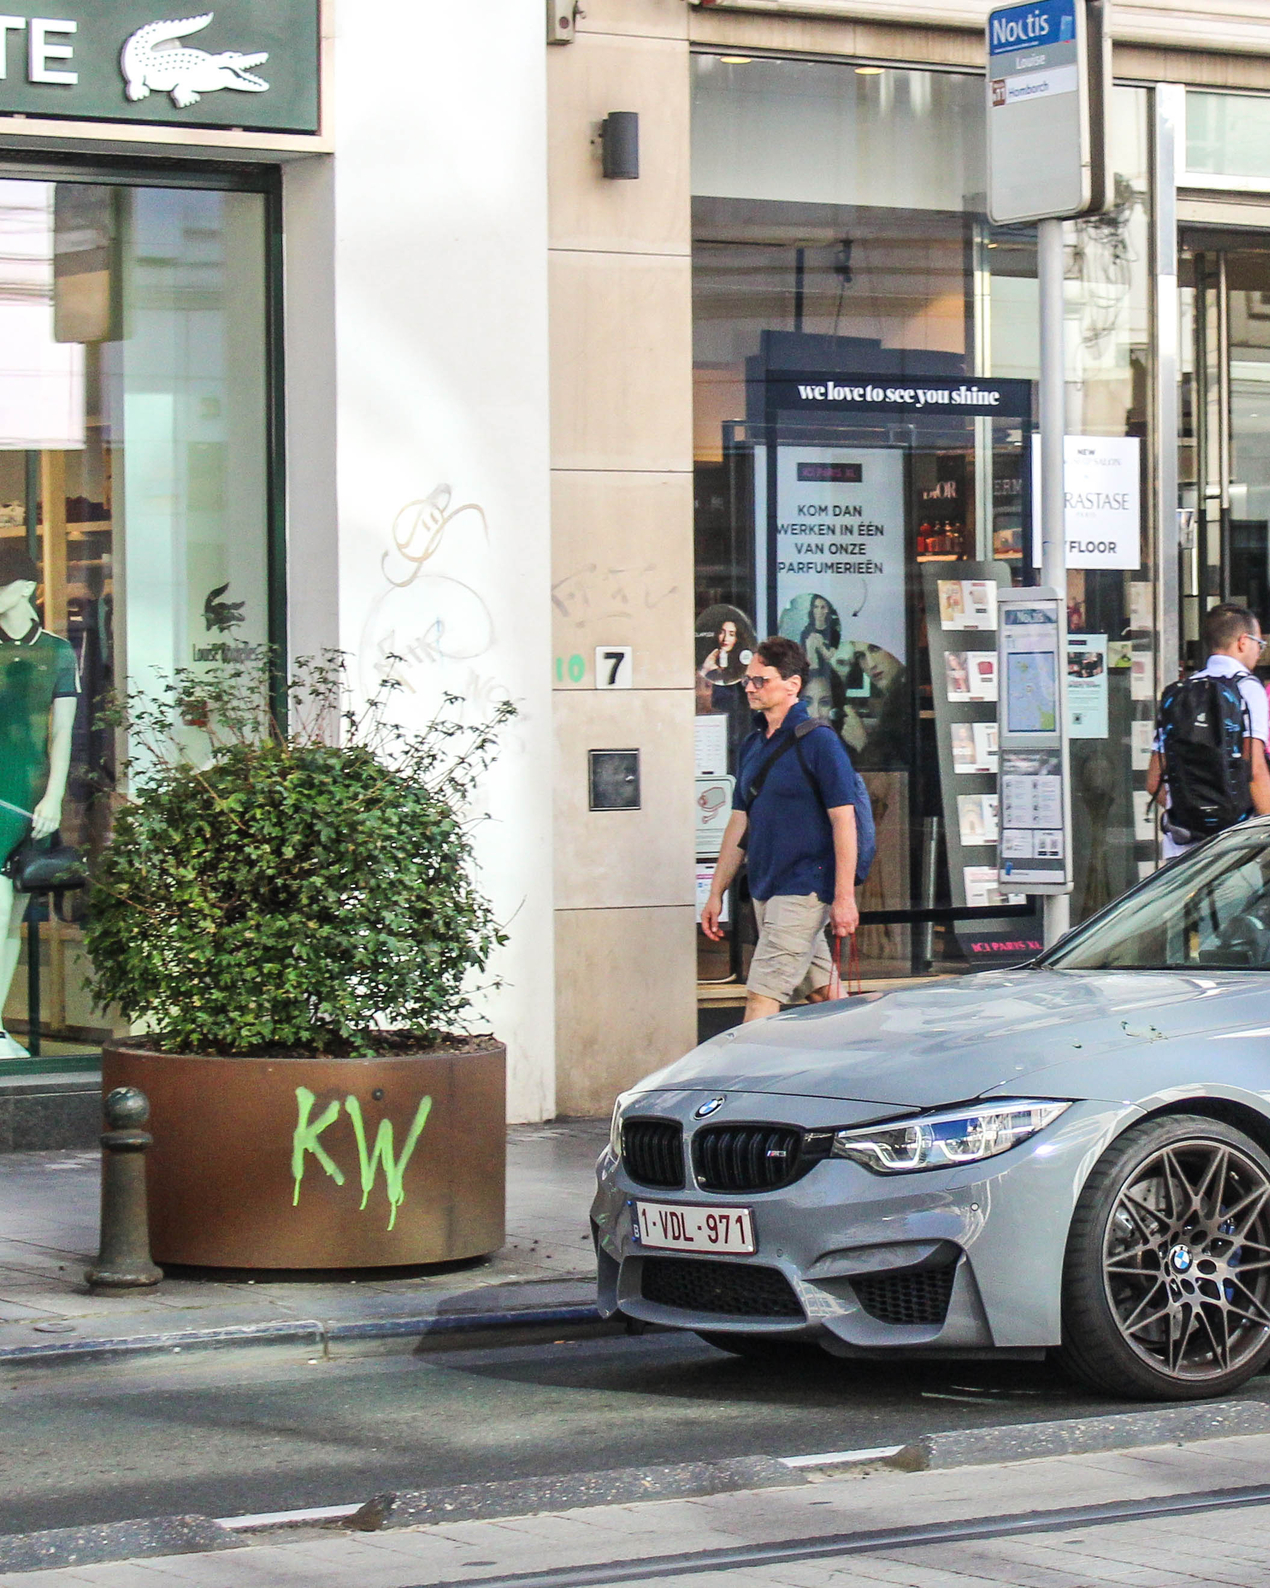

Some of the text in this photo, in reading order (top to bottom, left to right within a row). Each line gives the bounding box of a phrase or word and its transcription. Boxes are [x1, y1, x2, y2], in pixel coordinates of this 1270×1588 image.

[992, 10, 1050, 45] Noctis
[0, 14, 79, 85] TE
[1015, 53, 1047, 70] Louise
[798, 381, 1000, 408] we love to see you shine
[797, 504, 863, 517] KOM DAN
[777, 521, 885, 537] WERKEN IN ÉÉN
[795, 542, 867, 556] VAN ONZE
[1068, 540, 1118, 554] FLOOR
[777, 558, 884, 575] PARFUMERIEËN
[555, 653, 586, 683] 10
[603, 652, 625, 685] 7
[291, 1086, 433, 1231] KW
[641, 1208, 746, 1245] 1-VDL-971
